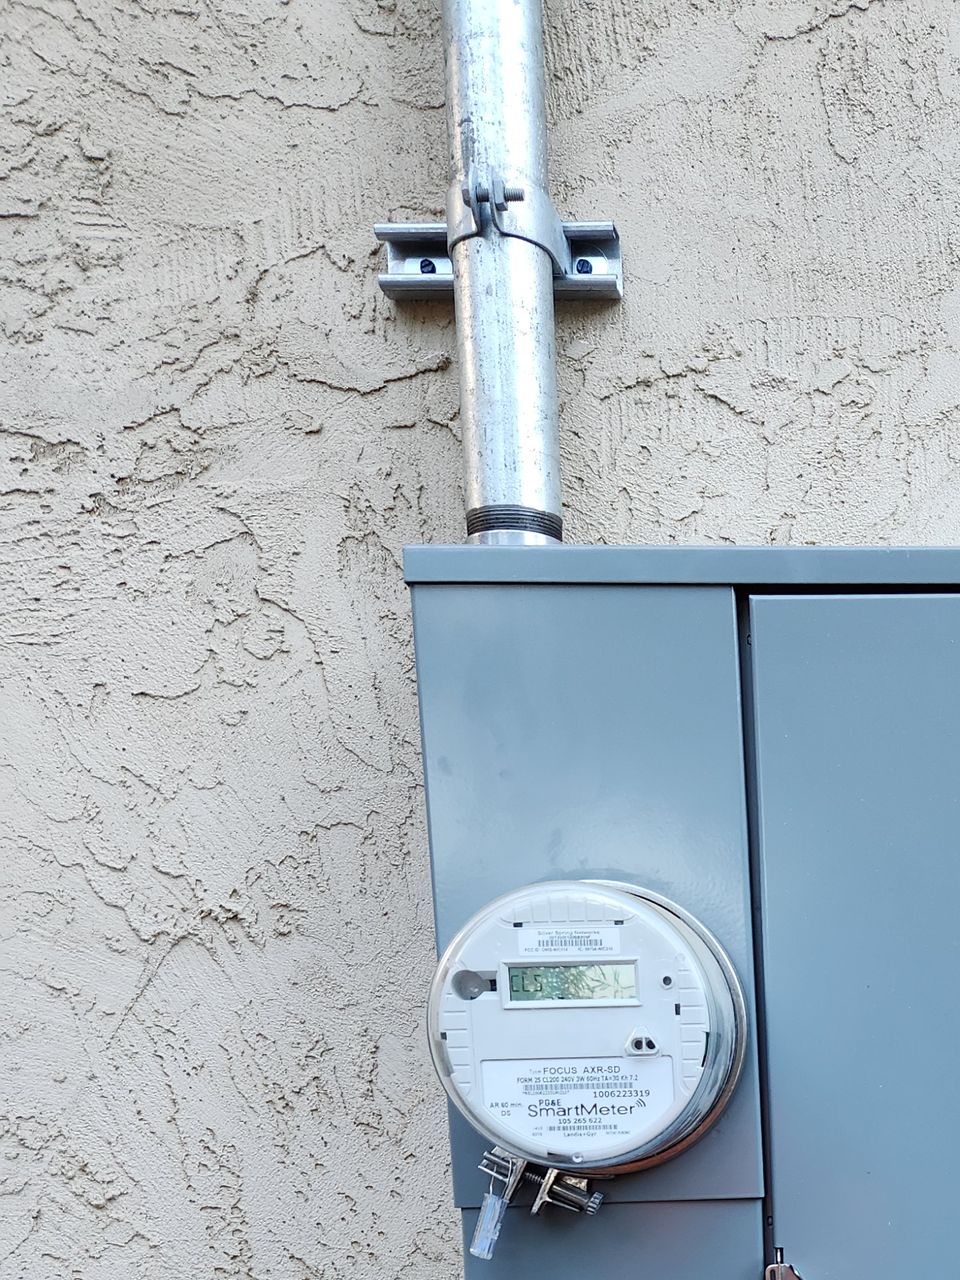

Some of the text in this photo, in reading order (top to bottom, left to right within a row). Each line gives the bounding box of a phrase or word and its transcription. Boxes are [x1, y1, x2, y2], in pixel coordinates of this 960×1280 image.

[543, 1066, 577, 1075] FOCUS
[583, 1065, 620, 1074] AXR-SD
[593, 1089, 650, 1098] 1006223319
[538, 1099, 561, 1107] PG&E
[527, 1103, 635, 1118] SmartMeter
